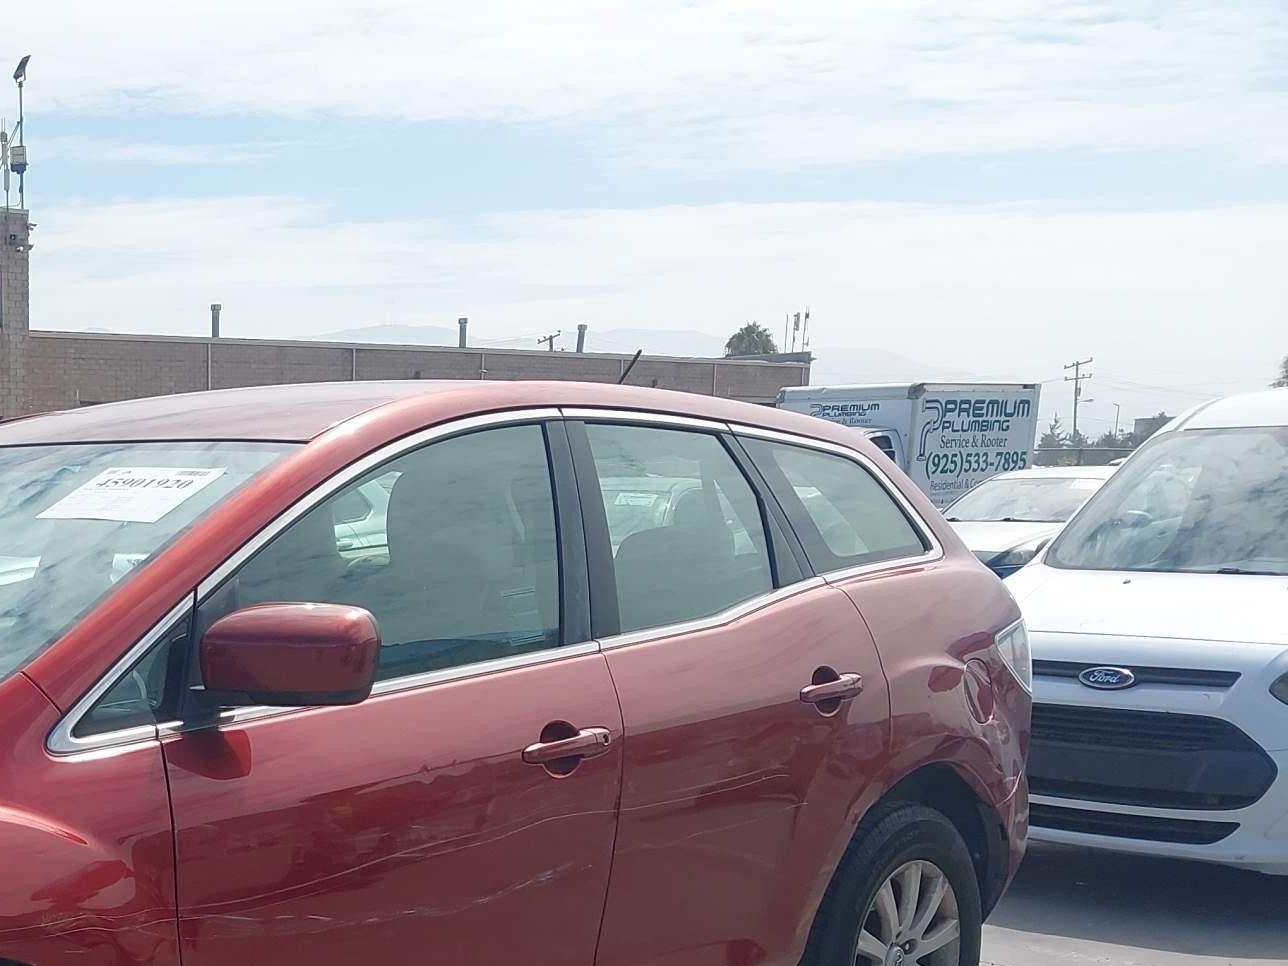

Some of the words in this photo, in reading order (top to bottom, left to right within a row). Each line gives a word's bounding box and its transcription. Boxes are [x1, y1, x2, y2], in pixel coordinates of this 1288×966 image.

[822, 403, 880, 412] PREMIUM
[943, 399, 1031, 418] PREMIUM
[941, 419, 1011, 433] PLUMBING
[940, 434, 970, 449] Service
[971, 433, 980, 448] &
[981, 433, 1008, 448] Rooter
[925, 449, 1028, 480] (925)533-7895
[96, 478, 194, 489] 45901920
[1089, 669, 1121, 683] Ford
